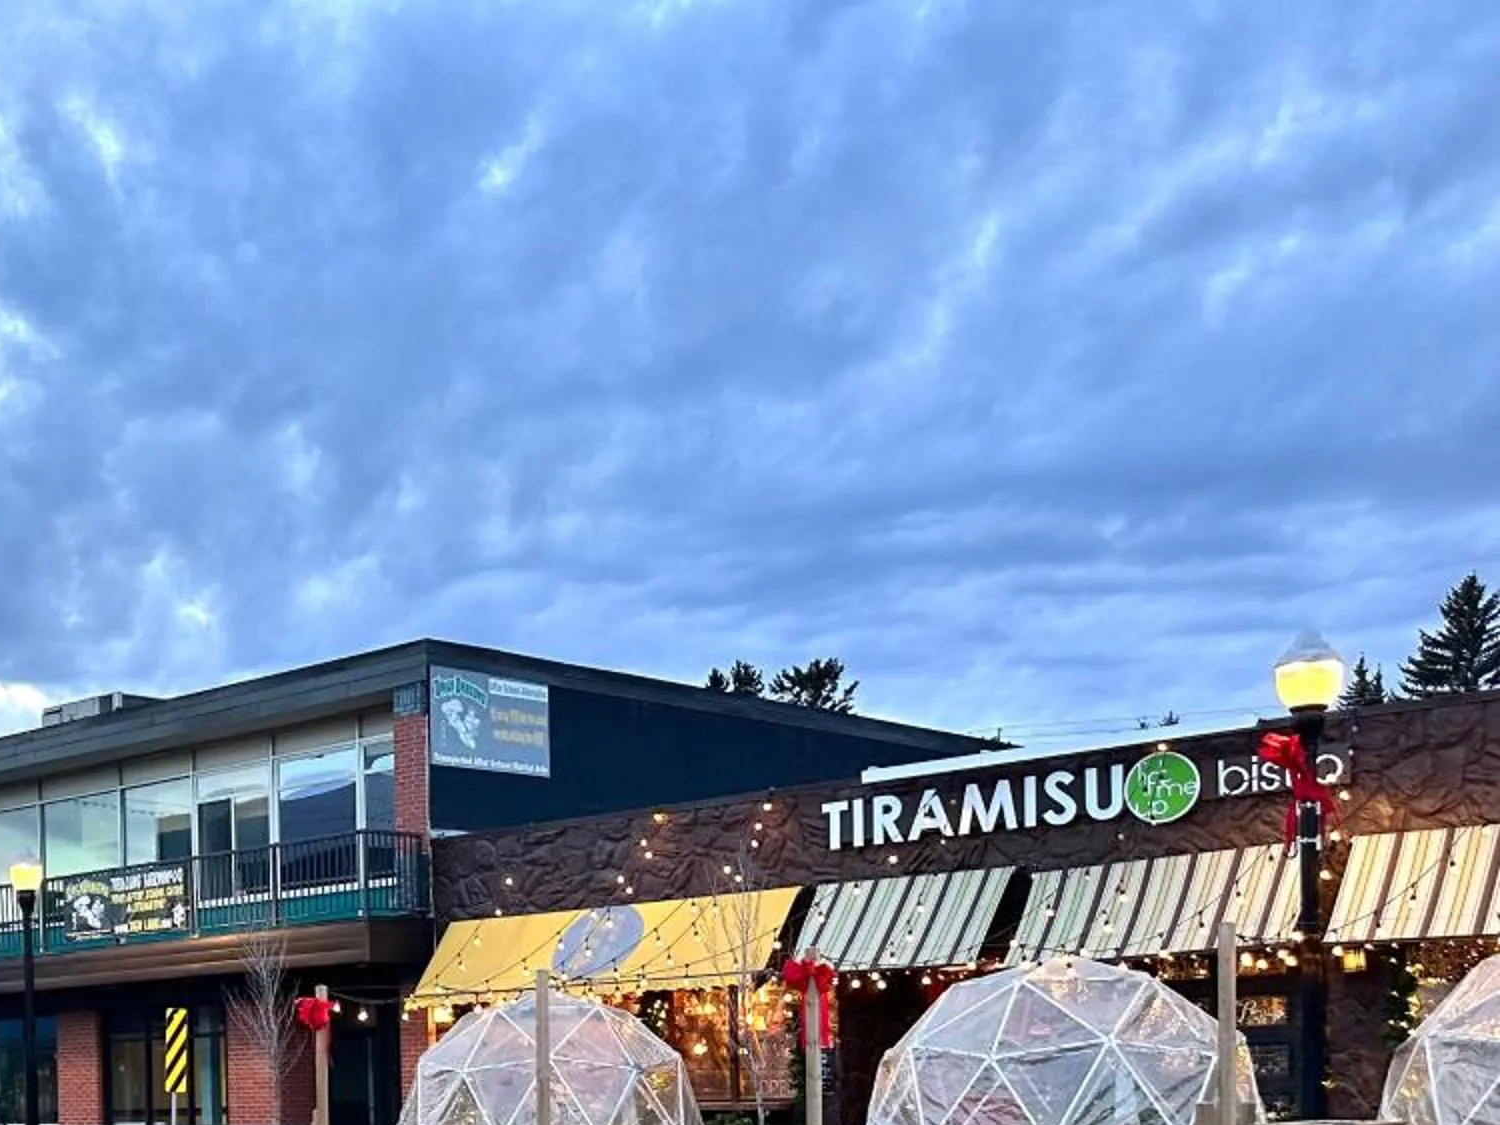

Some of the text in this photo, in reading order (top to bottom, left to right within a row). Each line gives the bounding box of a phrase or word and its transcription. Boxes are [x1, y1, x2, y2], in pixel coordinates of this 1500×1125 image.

[1156, 782, 1197, 796] me
[1218, 755, 1343, 796] biso
[821, 764, 1124, 850] TIRAMISU
